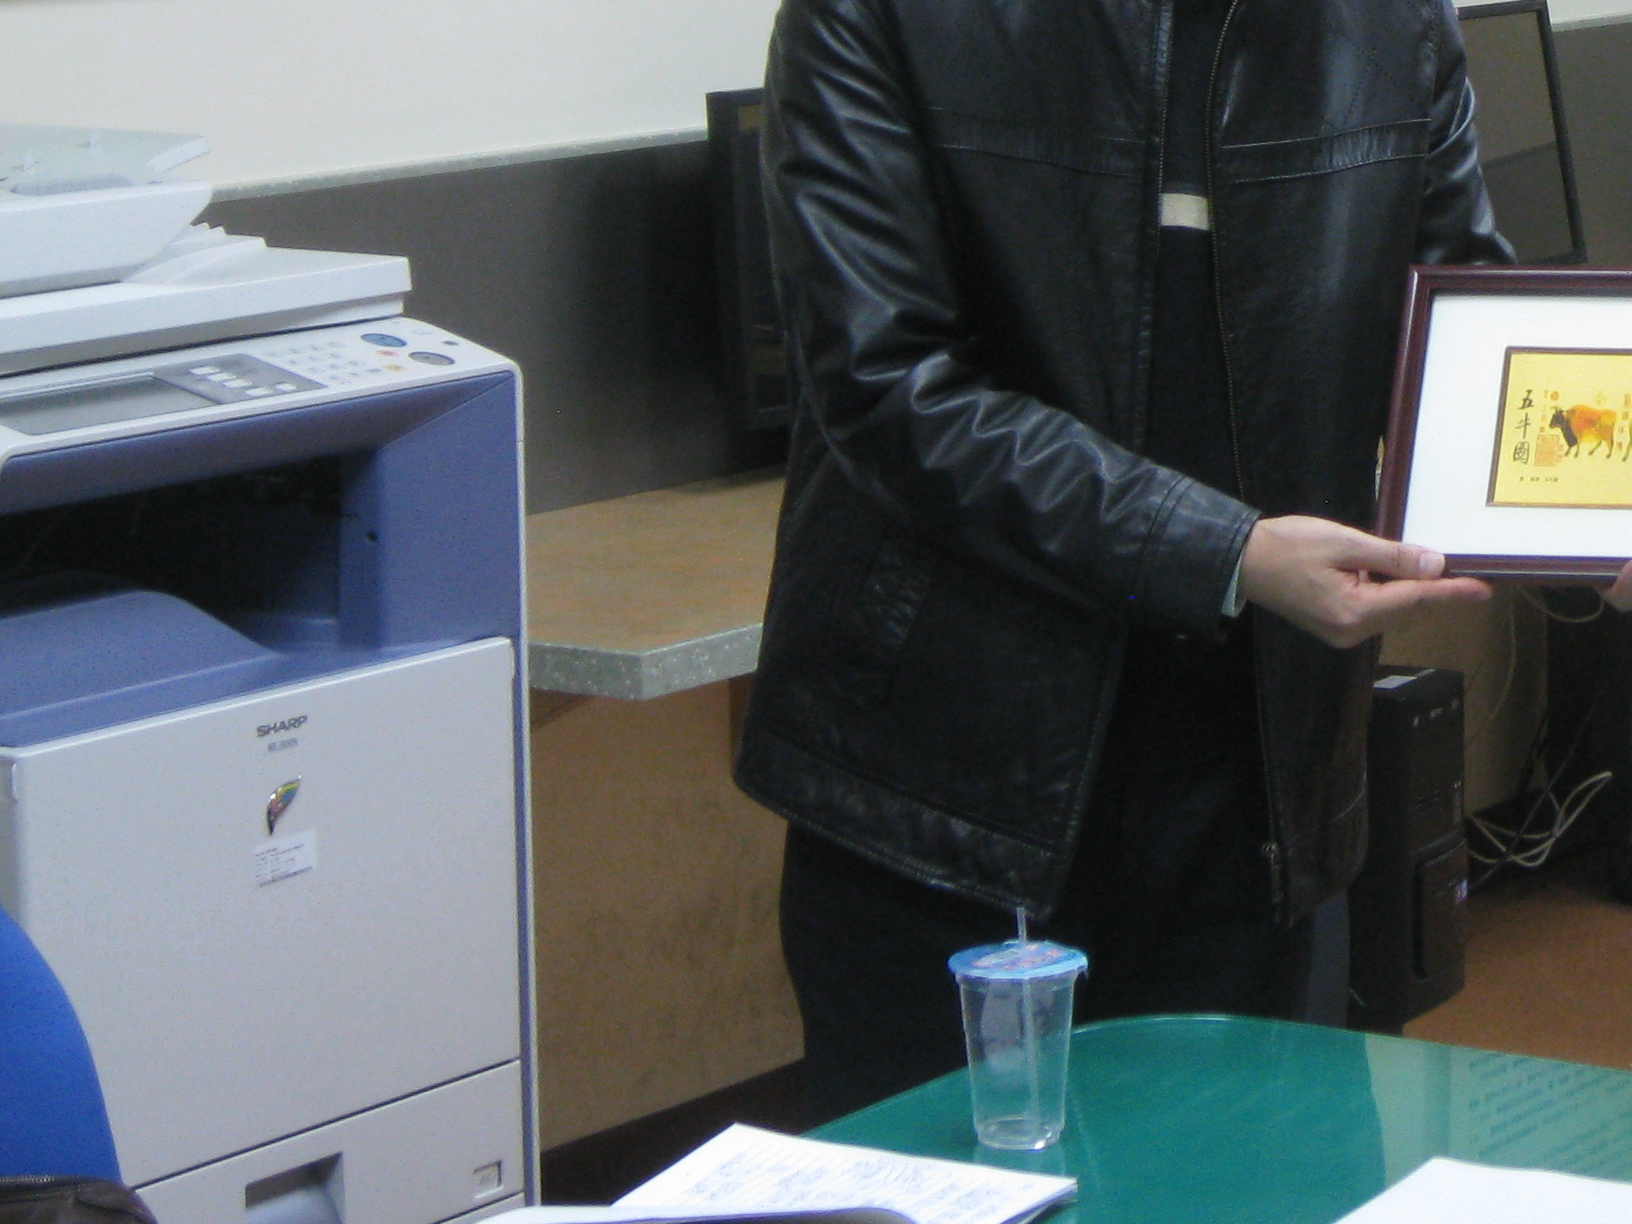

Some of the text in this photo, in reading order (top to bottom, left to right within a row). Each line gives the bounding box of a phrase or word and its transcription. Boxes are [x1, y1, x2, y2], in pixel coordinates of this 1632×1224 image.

[1513, 389, 1534, 465] 五牛圖
[257, 714, 308, 737] SHARP
